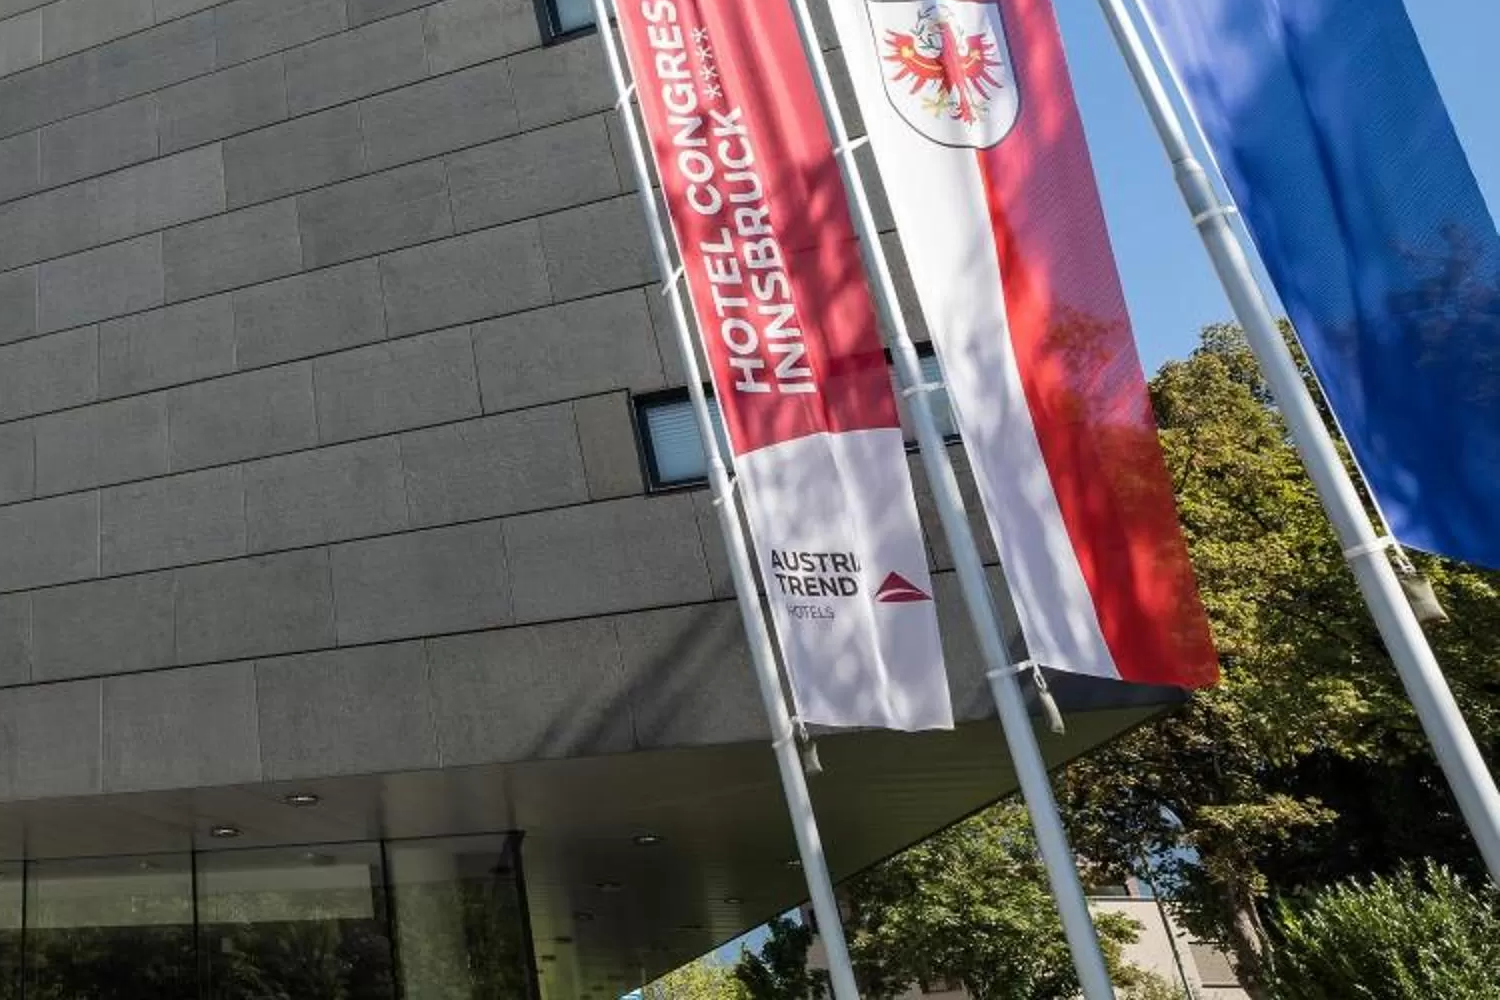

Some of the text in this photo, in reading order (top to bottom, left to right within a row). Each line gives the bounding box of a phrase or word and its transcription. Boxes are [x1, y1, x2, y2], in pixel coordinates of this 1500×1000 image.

[714, 106, 817, 394] INNSBRUCK
[700, 227, 772, 394] HOTEL
[771, 549, 861, 573] AUSTRI
[775, 574, 858, 597] TREND
[787, 604, 835, 620] HOTELS
